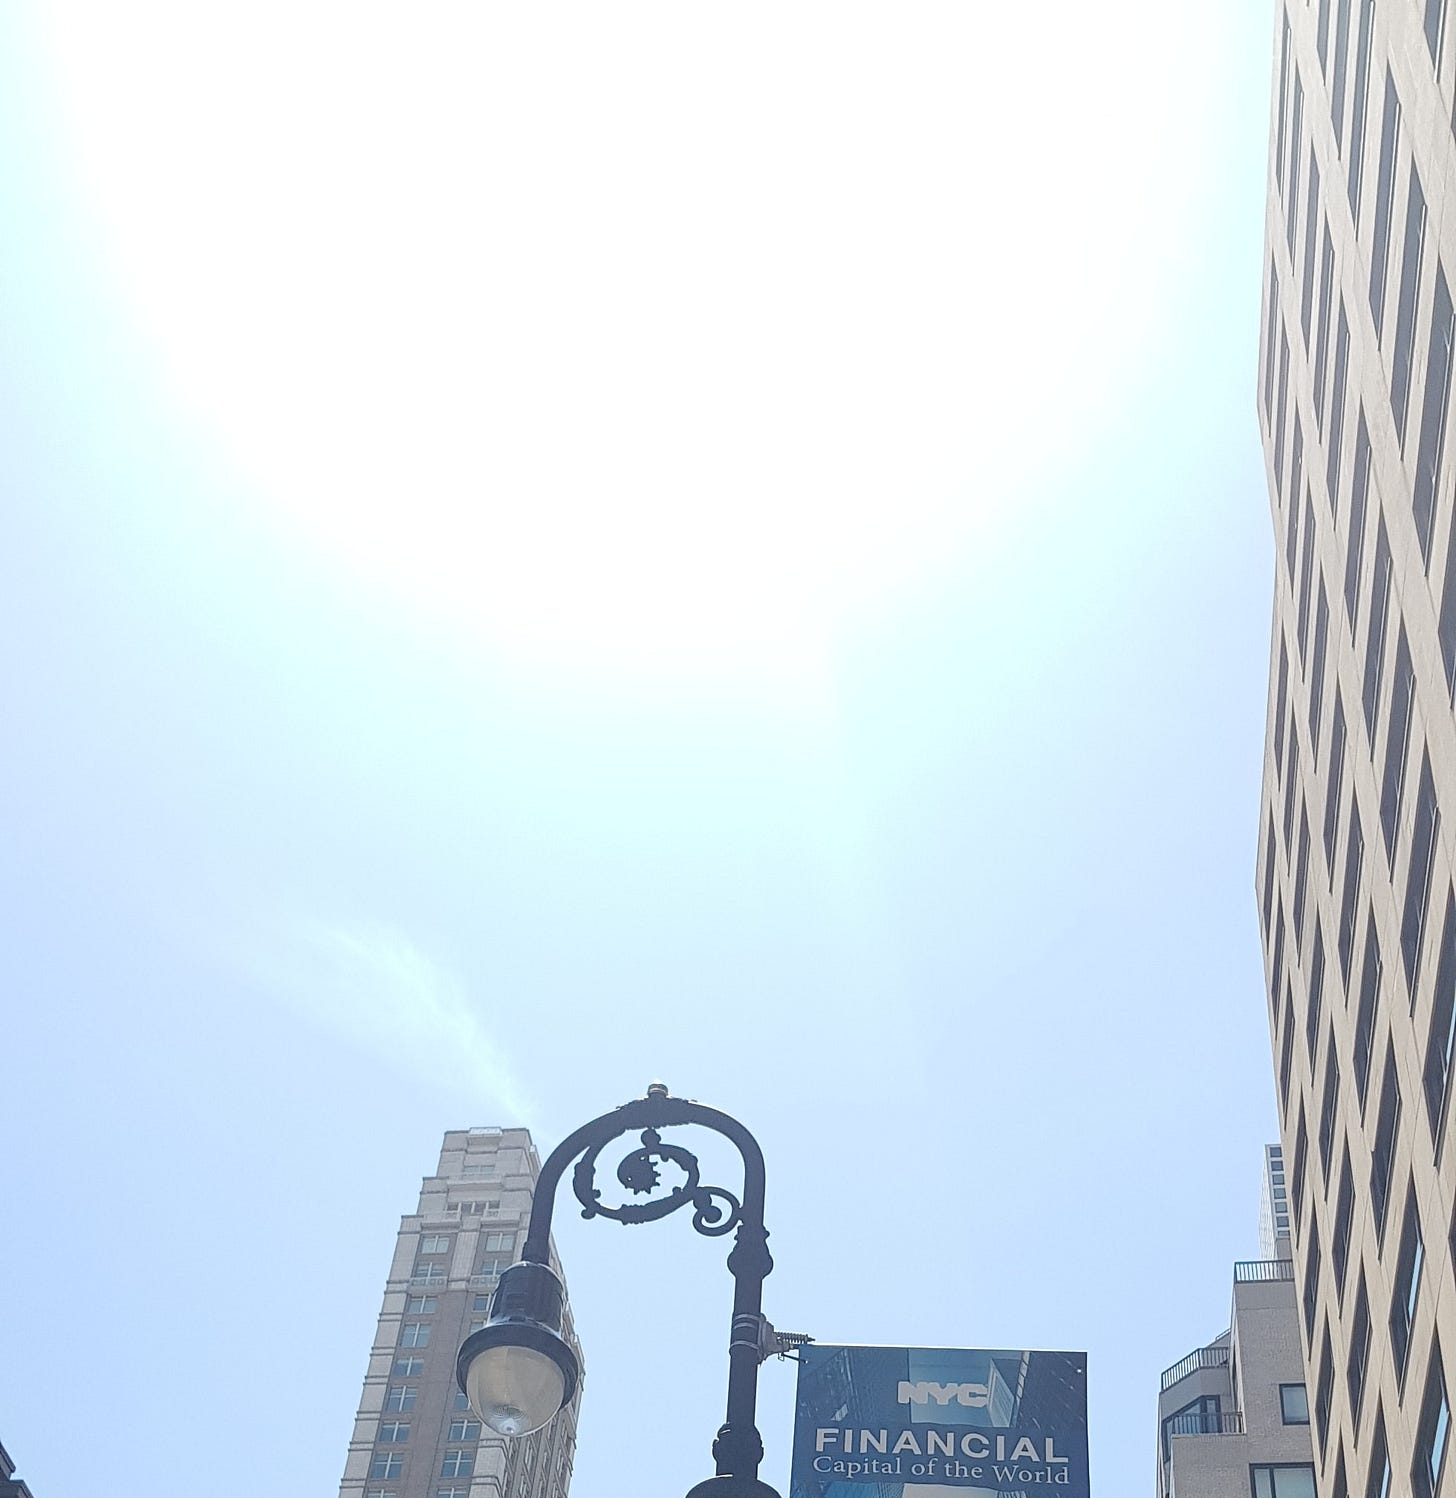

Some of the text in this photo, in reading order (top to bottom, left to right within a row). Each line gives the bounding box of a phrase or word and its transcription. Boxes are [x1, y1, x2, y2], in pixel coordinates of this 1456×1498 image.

[897, 1381, 988, 1407] NYC
[815, 1428, 1069, 1463] FINANCIAL
[813, 1456, 1070, 1484] Capital of the World
